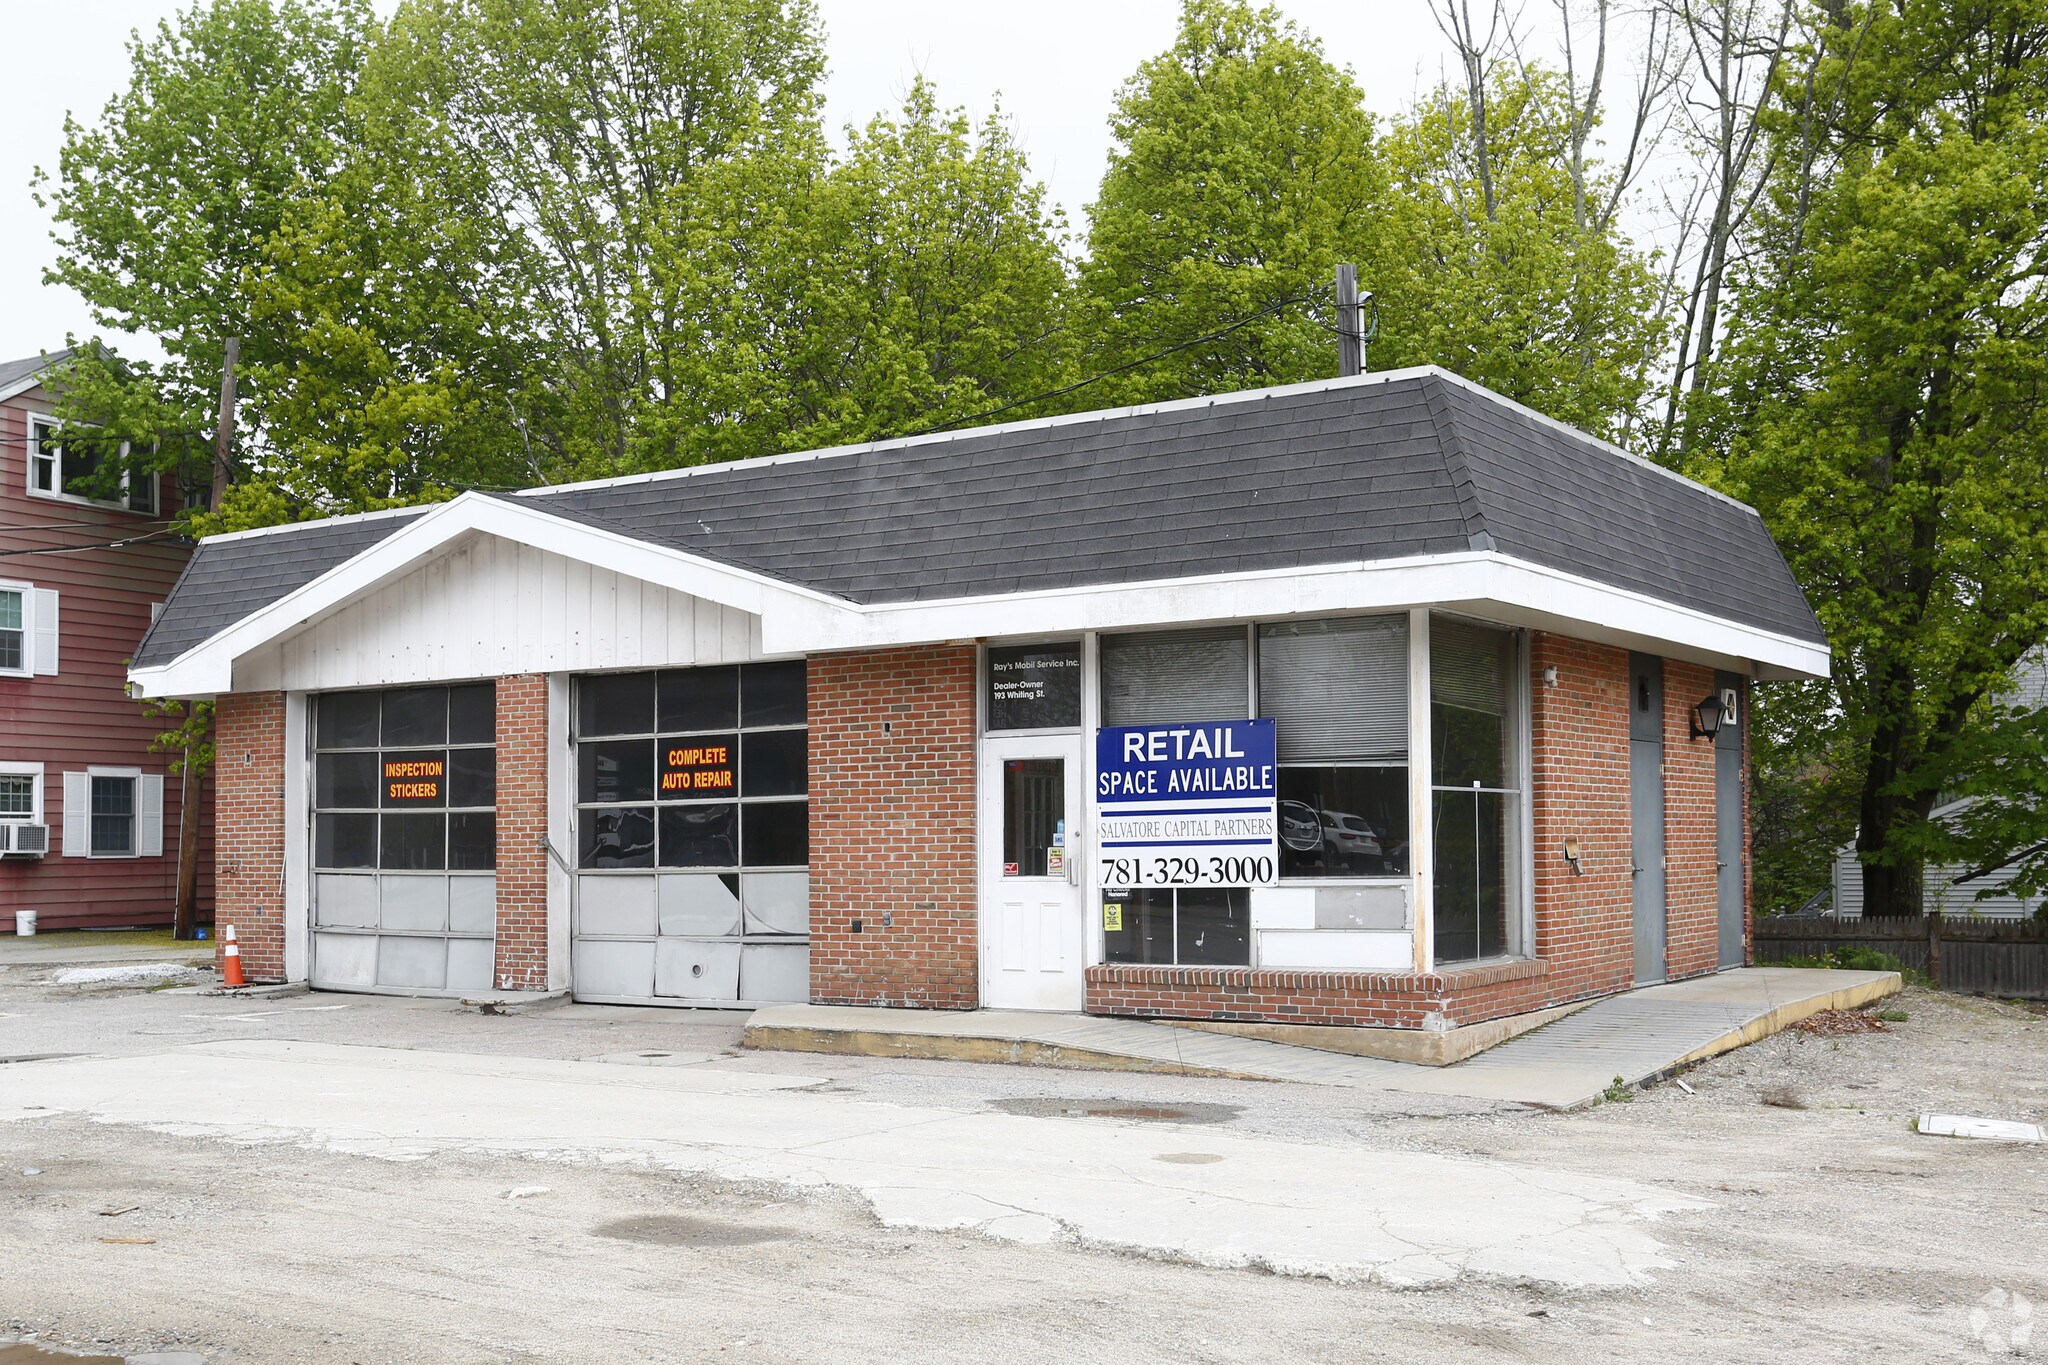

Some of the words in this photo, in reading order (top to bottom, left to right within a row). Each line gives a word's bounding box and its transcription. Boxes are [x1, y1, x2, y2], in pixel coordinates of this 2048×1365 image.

[993, 662, 1013, 671] Ray's
[1014, 661, 1035, 670] Mobil
[1036, 660, 1064, 668] Service
[1065, 659, 1080, 667] Inc.
[993, 681, 1044, 690] Dealer-Owner
[993, 691, 1006, 700] 193
[1006, 690, 1035, 700] Whiting
[1035, 689, 1046, 698] St.
[1123, 727, 1245, 763] RETAIL
[668, 747, 727, 767] COMPLETE
[385, 761, 443, 778] INSPECTION
[662, 772, 691, 789] AUTO
[694, 770, 732, 788] REPAIR
[1099, 770, 1158, 796] SPACE
[1167, 765, 1273, 793] AVAILABLE
[389, 782, 438, 798] STICKERS
[1100, 821, 1161, 839] SALVATORE
[1164, 820, 1212, 837] CAPITAL
[1214, 818, 1273, 836] PARTNERS
[1101, 856, 1274, 885] 781-329-3000
